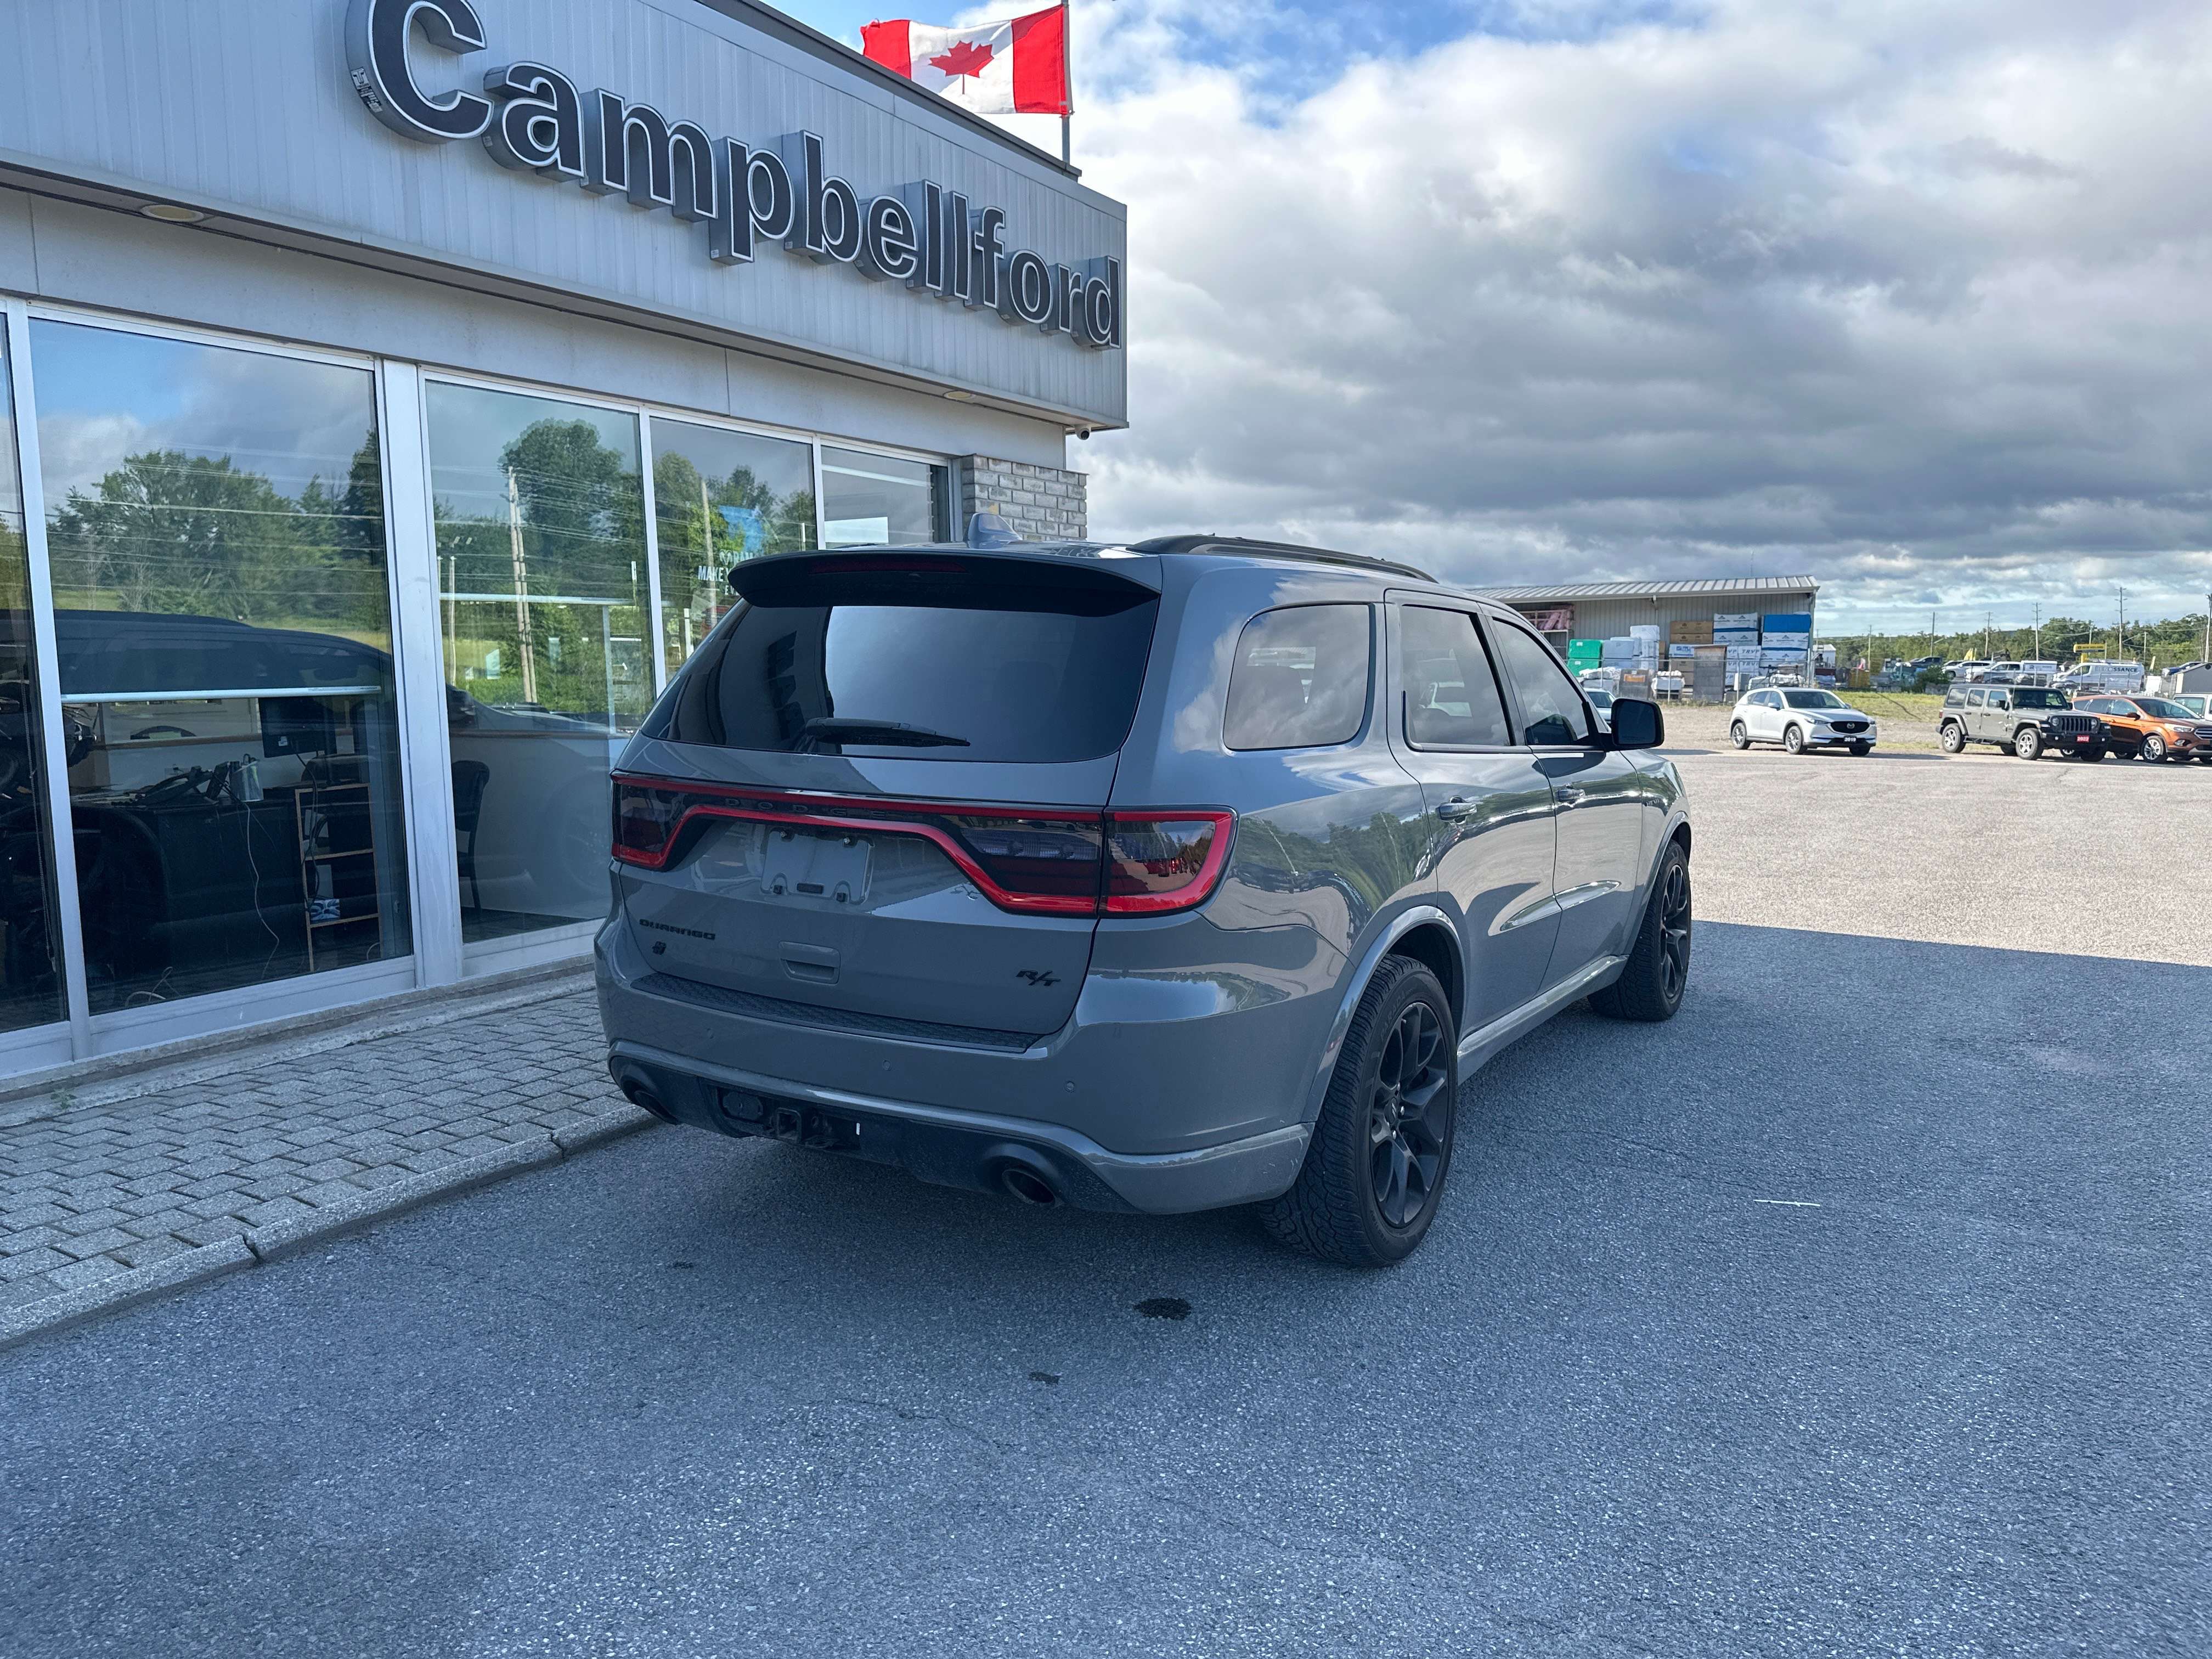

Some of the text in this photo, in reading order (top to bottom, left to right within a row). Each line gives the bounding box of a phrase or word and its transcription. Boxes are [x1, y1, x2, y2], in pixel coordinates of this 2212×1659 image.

[347, 0, 1121, 350] Campbellford
[698, 565, 724, 582] MAKE
[725, 797, 887, 819] DODGE
[1015, 969, 1062, 986] R/T
